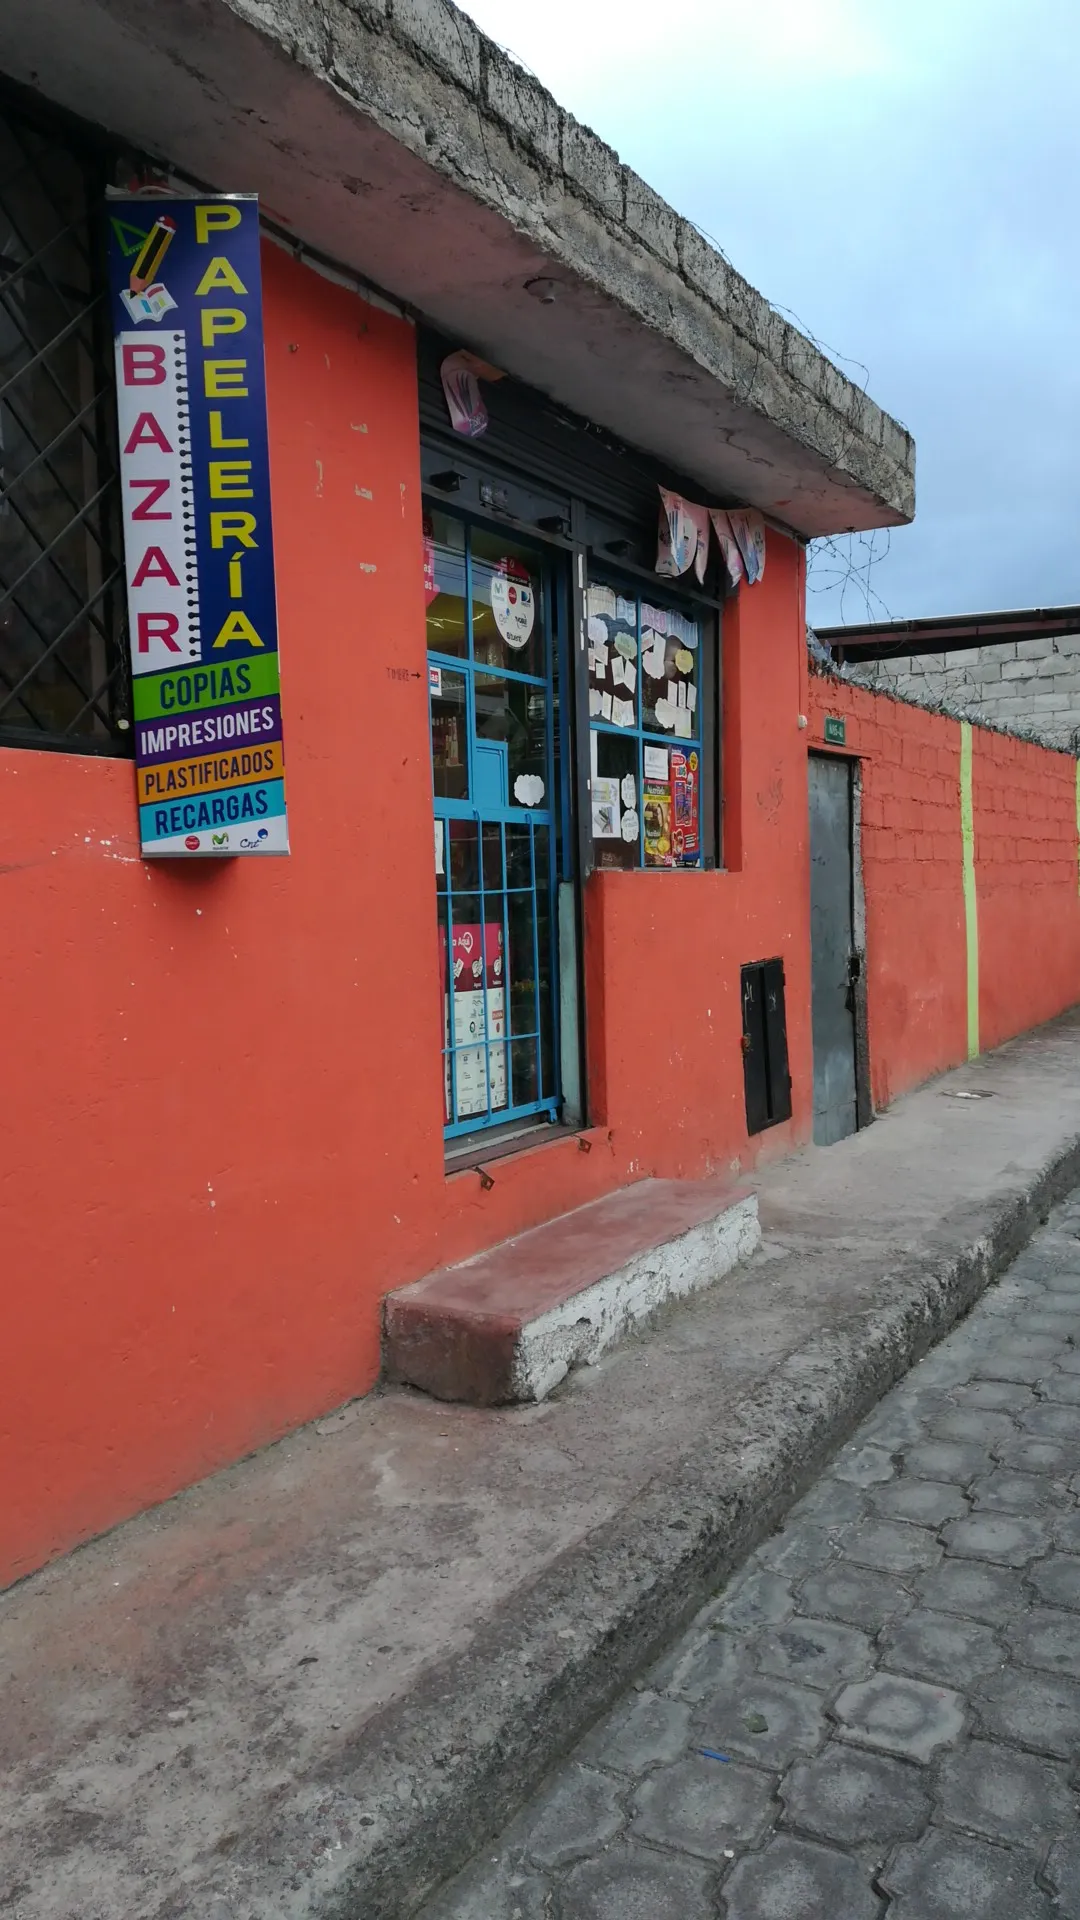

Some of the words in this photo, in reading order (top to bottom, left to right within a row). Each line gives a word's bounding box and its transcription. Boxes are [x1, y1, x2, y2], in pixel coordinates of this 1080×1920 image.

[194, 204, 265, 648] PAPELERÍA
[121, 343, 182, 654] BAZAR
[160, 663, 252, 710] COPIAS
[141, 706, 275, 756] IMPRESIONES
[145, 749, 274, 796] PLASTIFICADOS
[155, 788, 269, 836] RECARGAS
